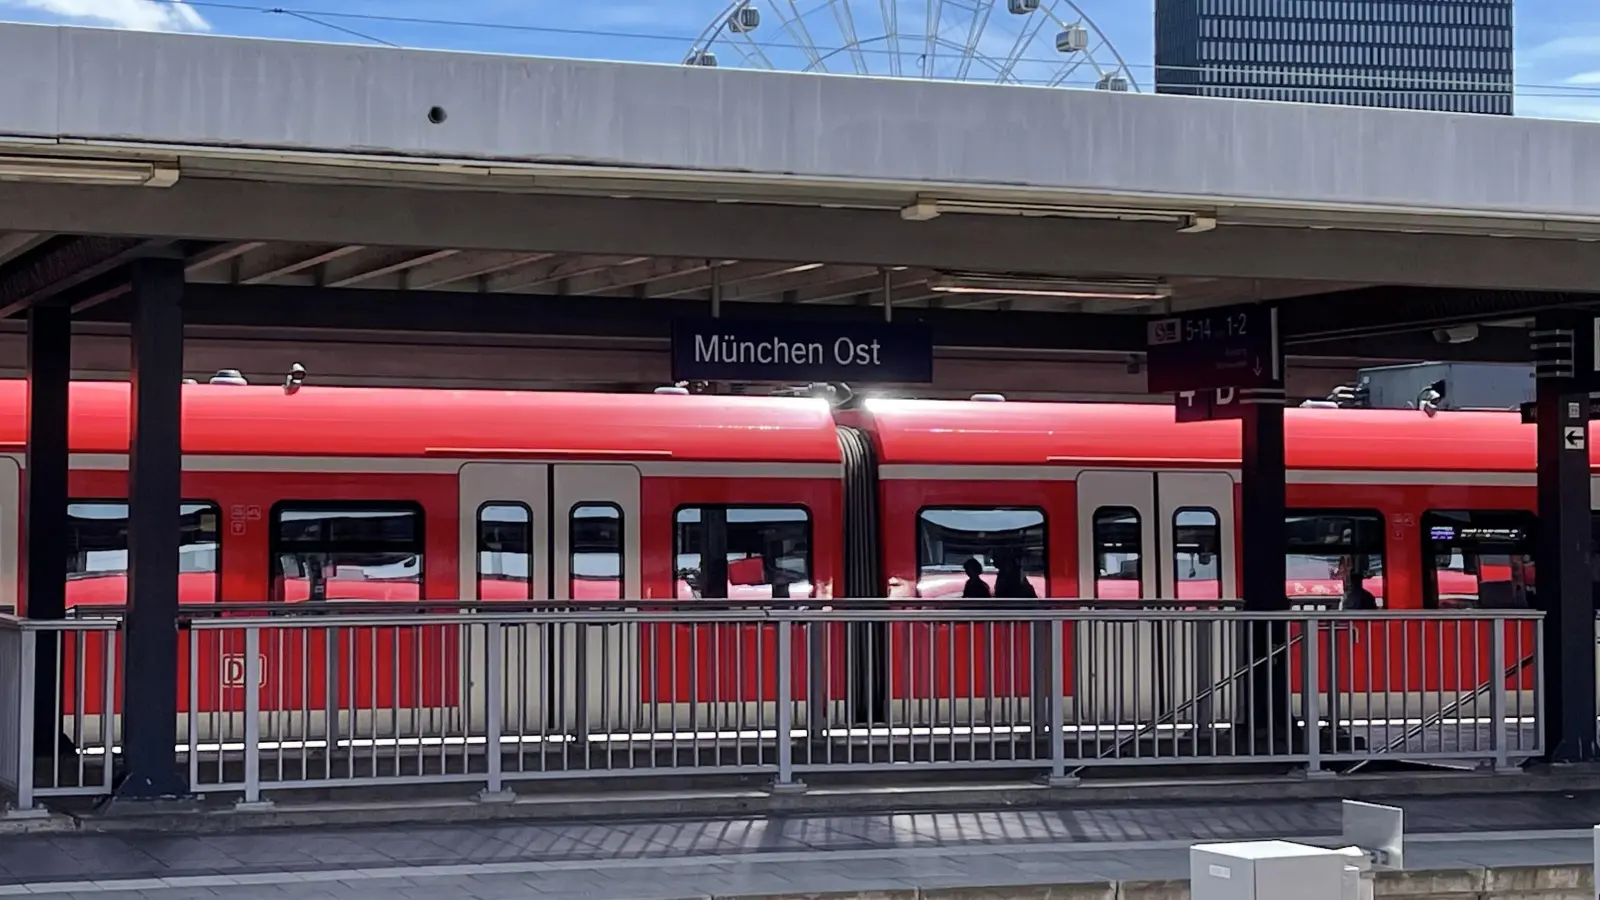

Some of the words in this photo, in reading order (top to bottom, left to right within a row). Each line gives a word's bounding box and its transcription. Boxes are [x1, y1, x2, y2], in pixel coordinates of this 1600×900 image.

[1227, 313, 1247, 336] 1-2
[694, 334, 823, 364] München
[833, 336, 881, 365] Ost
